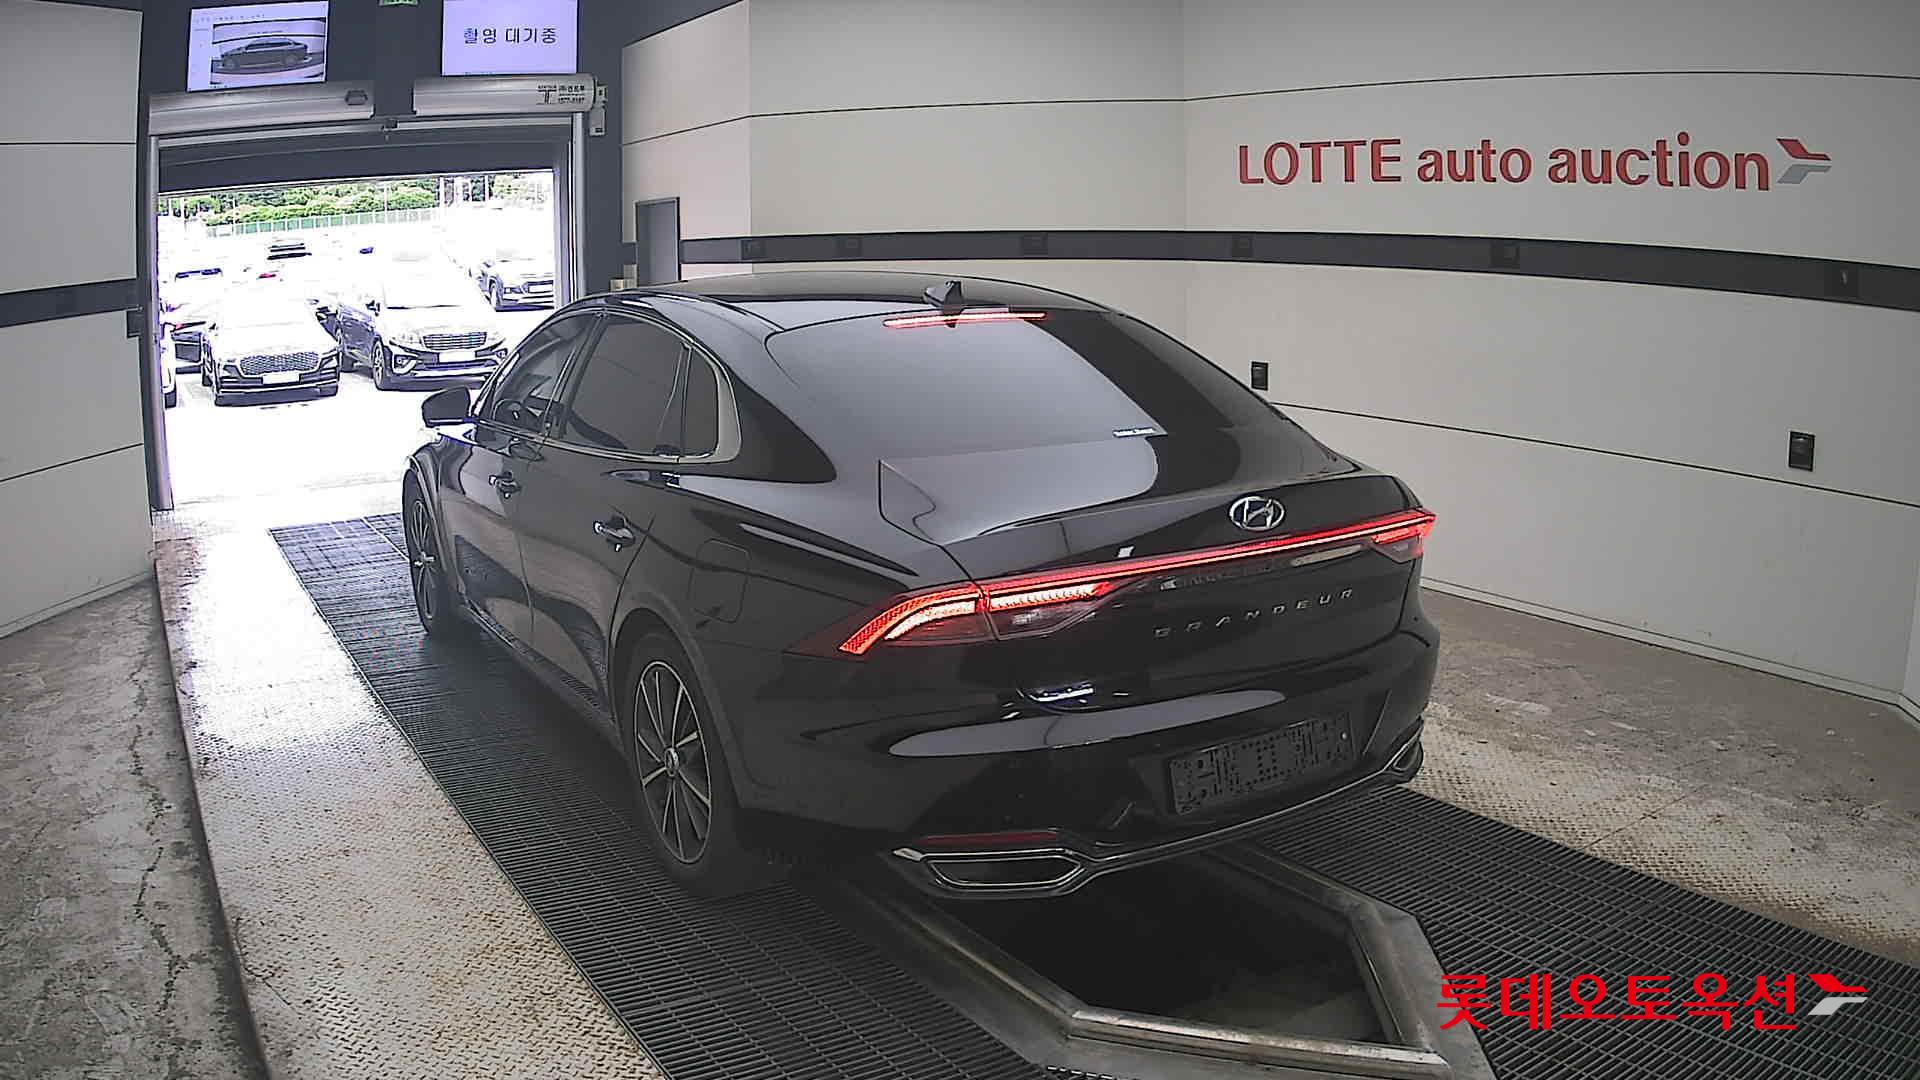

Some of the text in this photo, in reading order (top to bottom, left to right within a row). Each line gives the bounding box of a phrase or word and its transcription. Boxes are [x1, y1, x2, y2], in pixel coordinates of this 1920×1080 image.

[505, 27, 558, 44] 대기중
[1238, 131, 1770, 190] LOTTE auto auction
[1153, 587, 1354, 639] GRANDEUR
